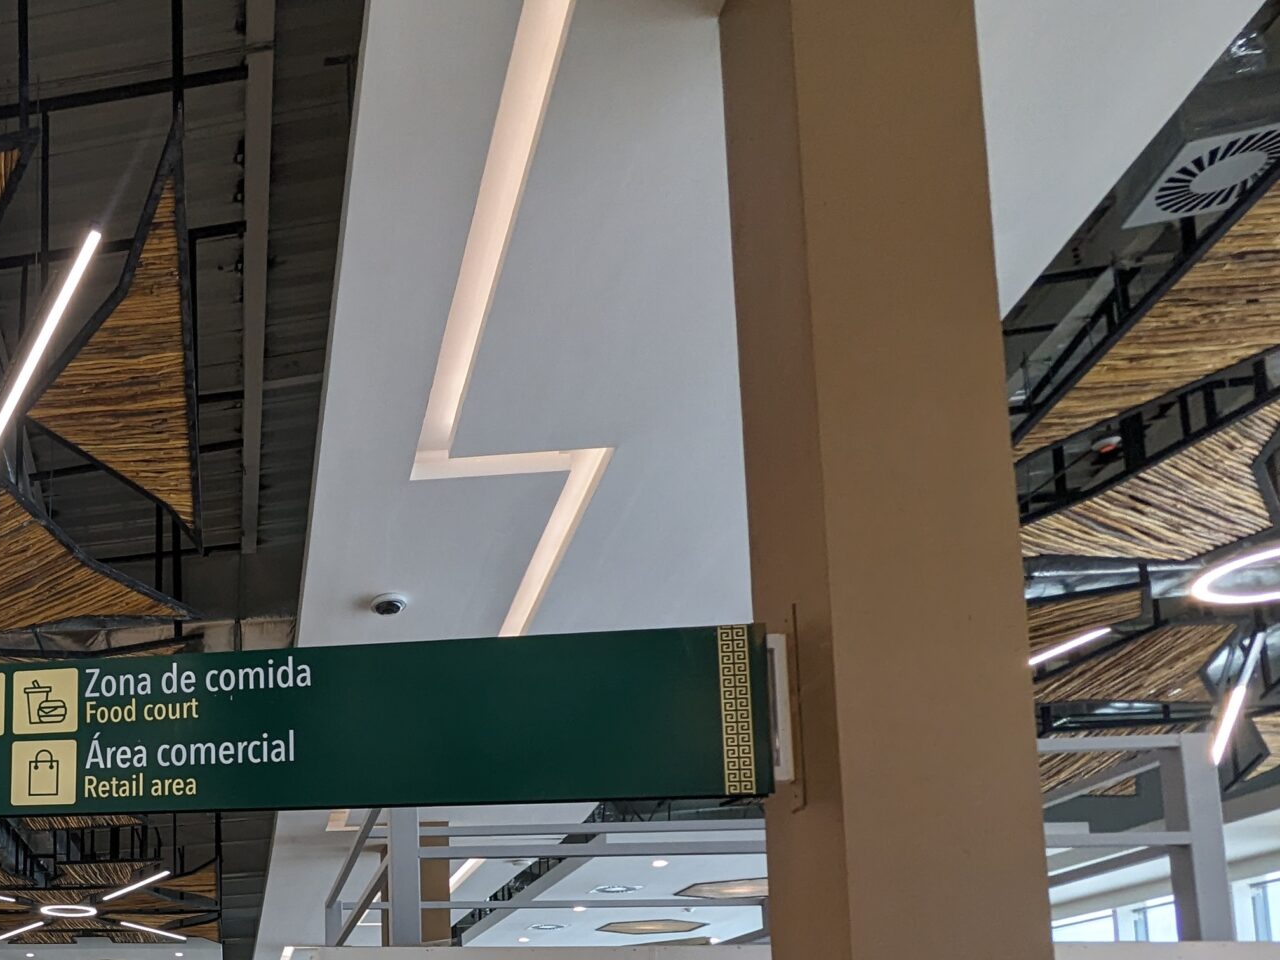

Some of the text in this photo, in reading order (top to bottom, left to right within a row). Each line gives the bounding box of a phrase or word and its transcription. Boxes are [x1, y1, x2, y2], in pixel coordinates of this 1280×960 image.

[84, 655, 311, 698] Zona de comida
[85, 698, 199, 723] Food court
[85, 729, 295, 769] Área comercial
[84, 772, 197, 798] Retail area
